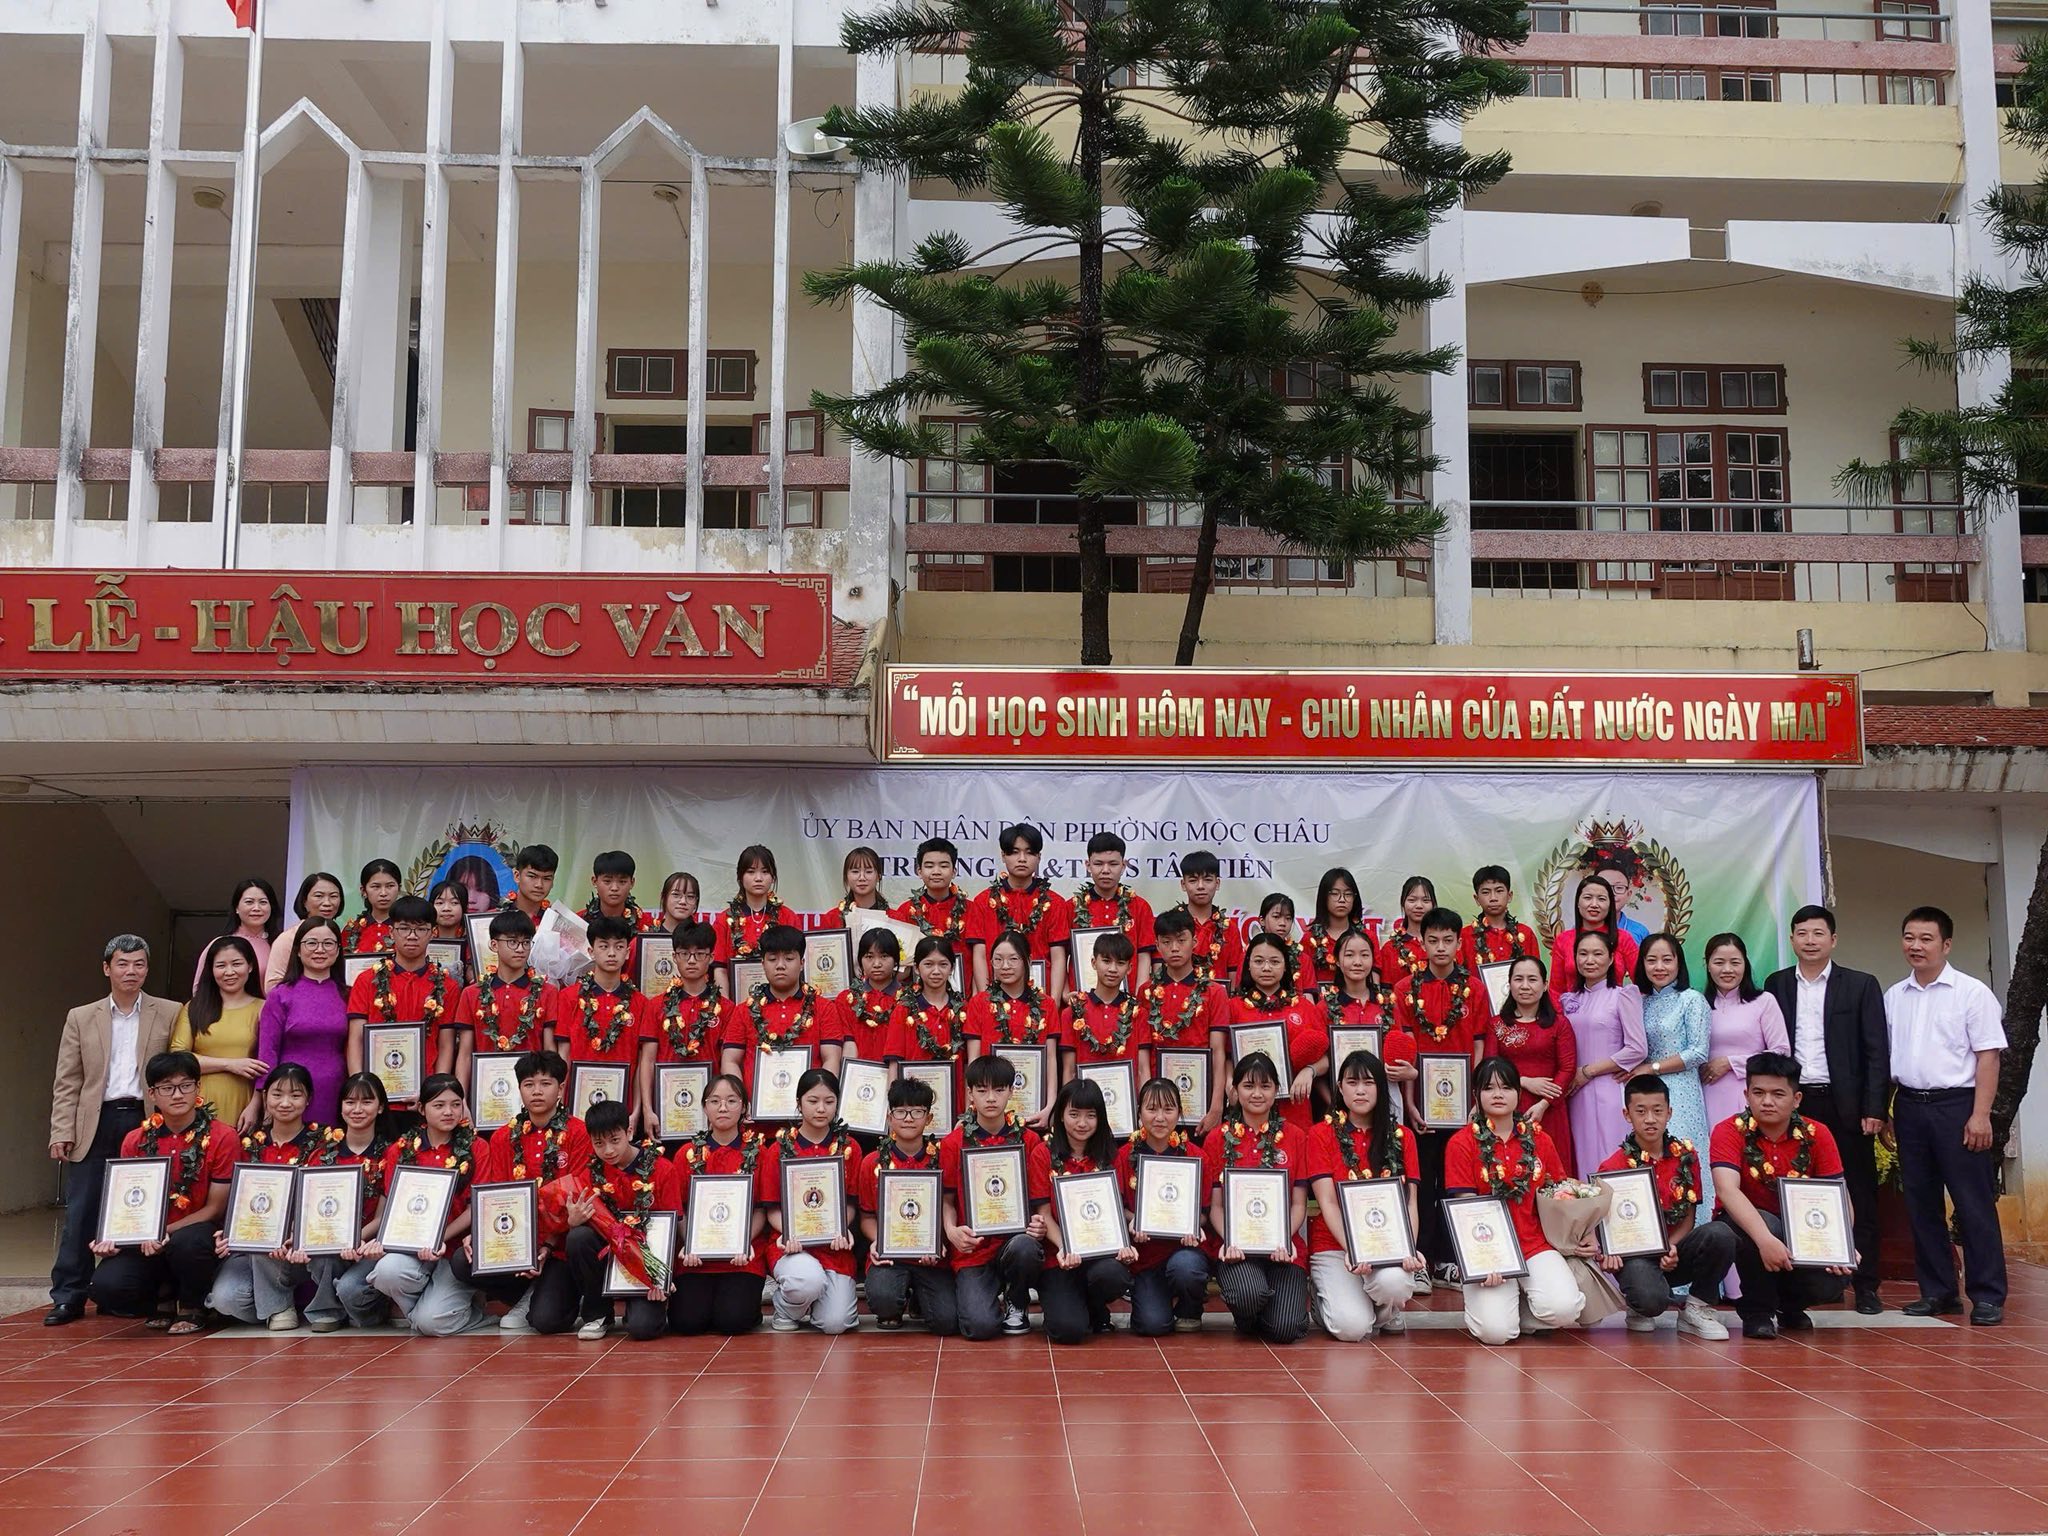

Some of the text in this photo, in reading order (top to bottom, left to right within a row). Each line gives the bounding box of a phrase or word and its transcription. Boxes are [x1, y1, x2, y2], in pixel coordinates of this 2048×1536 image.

[27, 574, 140, 652] LỄ
[191, 584, 373, 666] HẬU
[395, 602, 582, 670] HỌC
[601, 591, 770, 658] VĂN
[987, 697, 1046, 746] HỌC
[1057, 697, 1128, 738] SINH
[1138, 690, 1205, 738] HÔM
[1215, 698, 1272, 738] NAY
[1302, 685, 1361, 738] CHỦ
[1370, 691, 1452, 738] NHÂN
[1462, 686, 1521, 740] CỦA
[1530, 685, 1585, 740] ĐẤT
[1594, 692, 1673, 740] NƯỚC
[1684, 693, 1759, 741] NGÀY
[802, 812, 840, 838] ỦY
[847, 819, 904, 839] BAN
[912, 815, 990, 841] NHÂN
[1186, 819, 1246, 845] MỘC
[1254, 818, 1331, 843] CHÂU
[880, 856, 996, 878] TRNG
